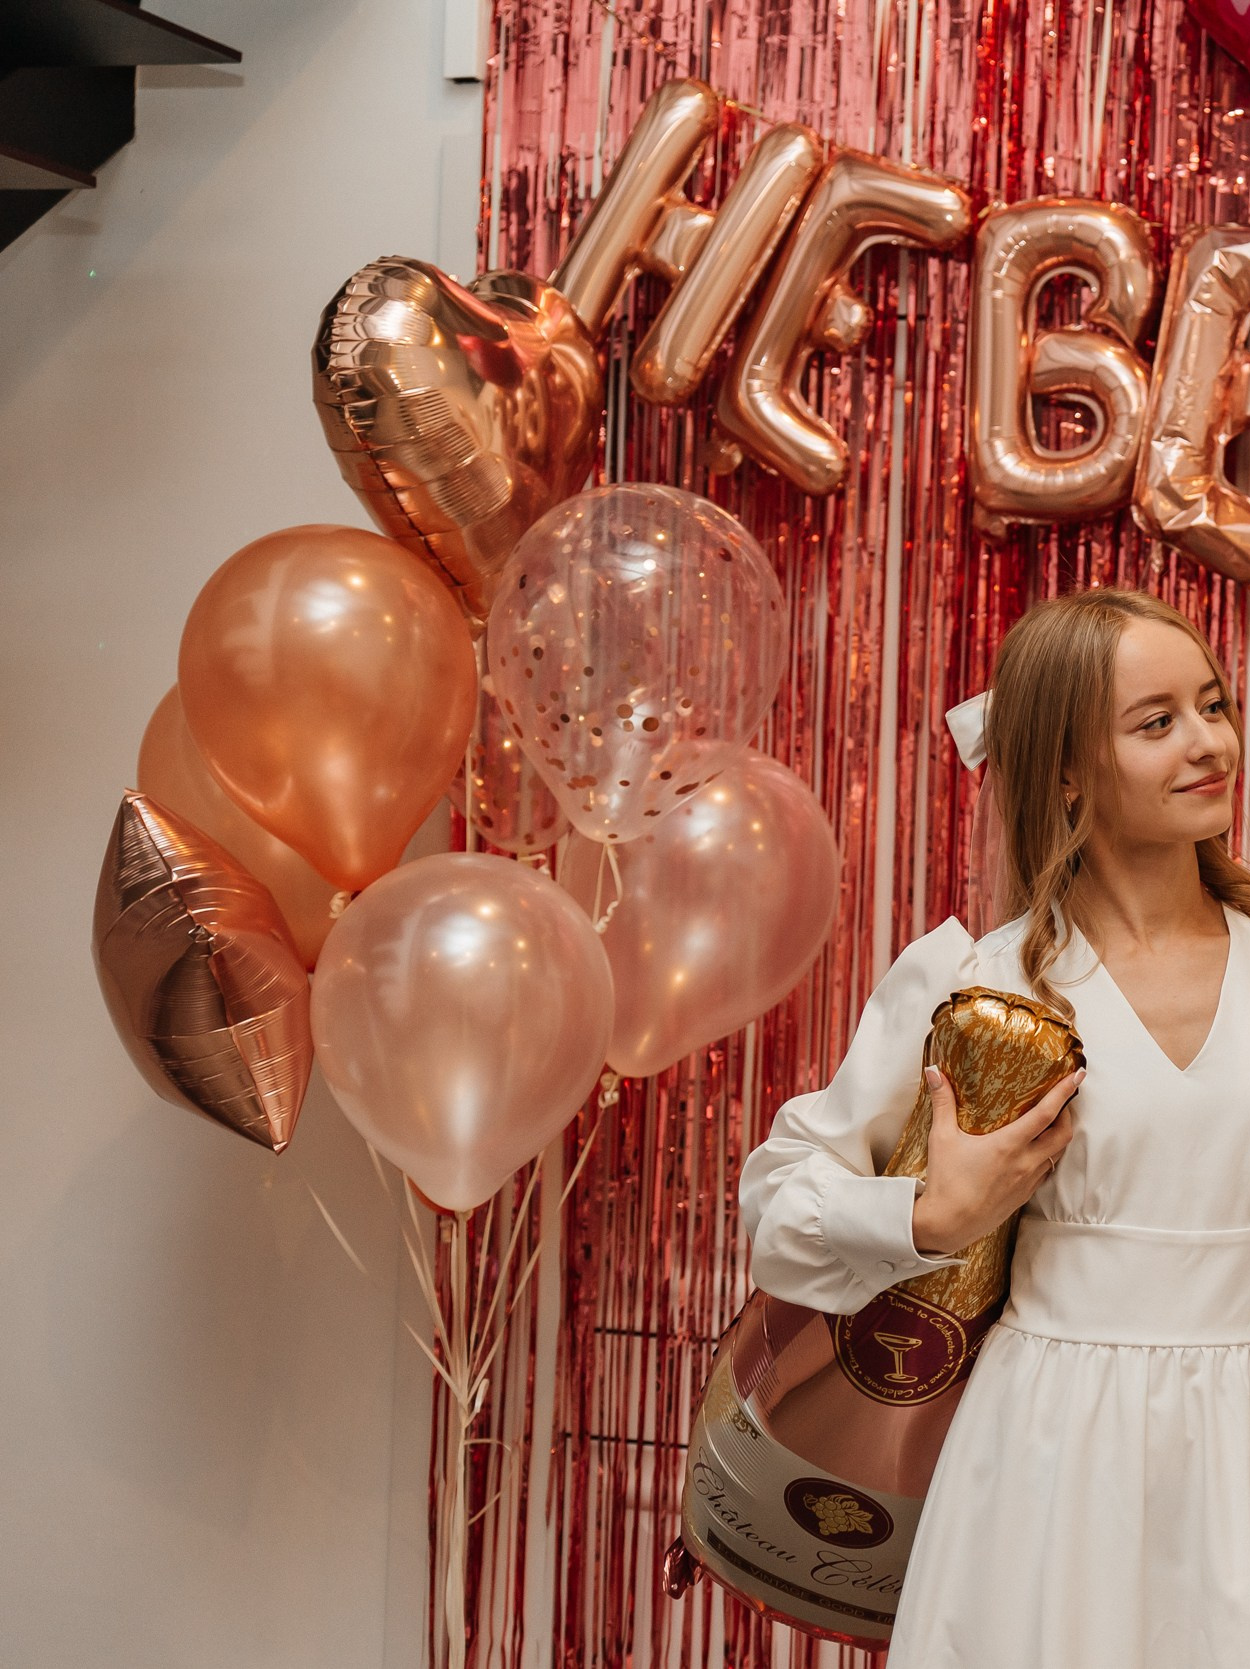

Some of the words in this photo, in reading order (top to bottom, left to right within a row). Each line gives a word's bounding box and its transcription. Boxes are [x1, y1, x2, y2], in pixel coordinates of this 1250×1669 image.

[888, 1296, 914, 1313] Time
[917, 1307, 928, 1319] to
[929, 1318, 956, 1354] Celebrate
[863, 1375, 915, 1398] Celebrate
[917, 1384, 929, 1392] to
[930, 1362, 953, 1384] Time
[692, 1446, 798, 1564] Château
[751, 1568, 807, 1598] VINTAGE
[820, 1599, 864, 1617] GOOD
